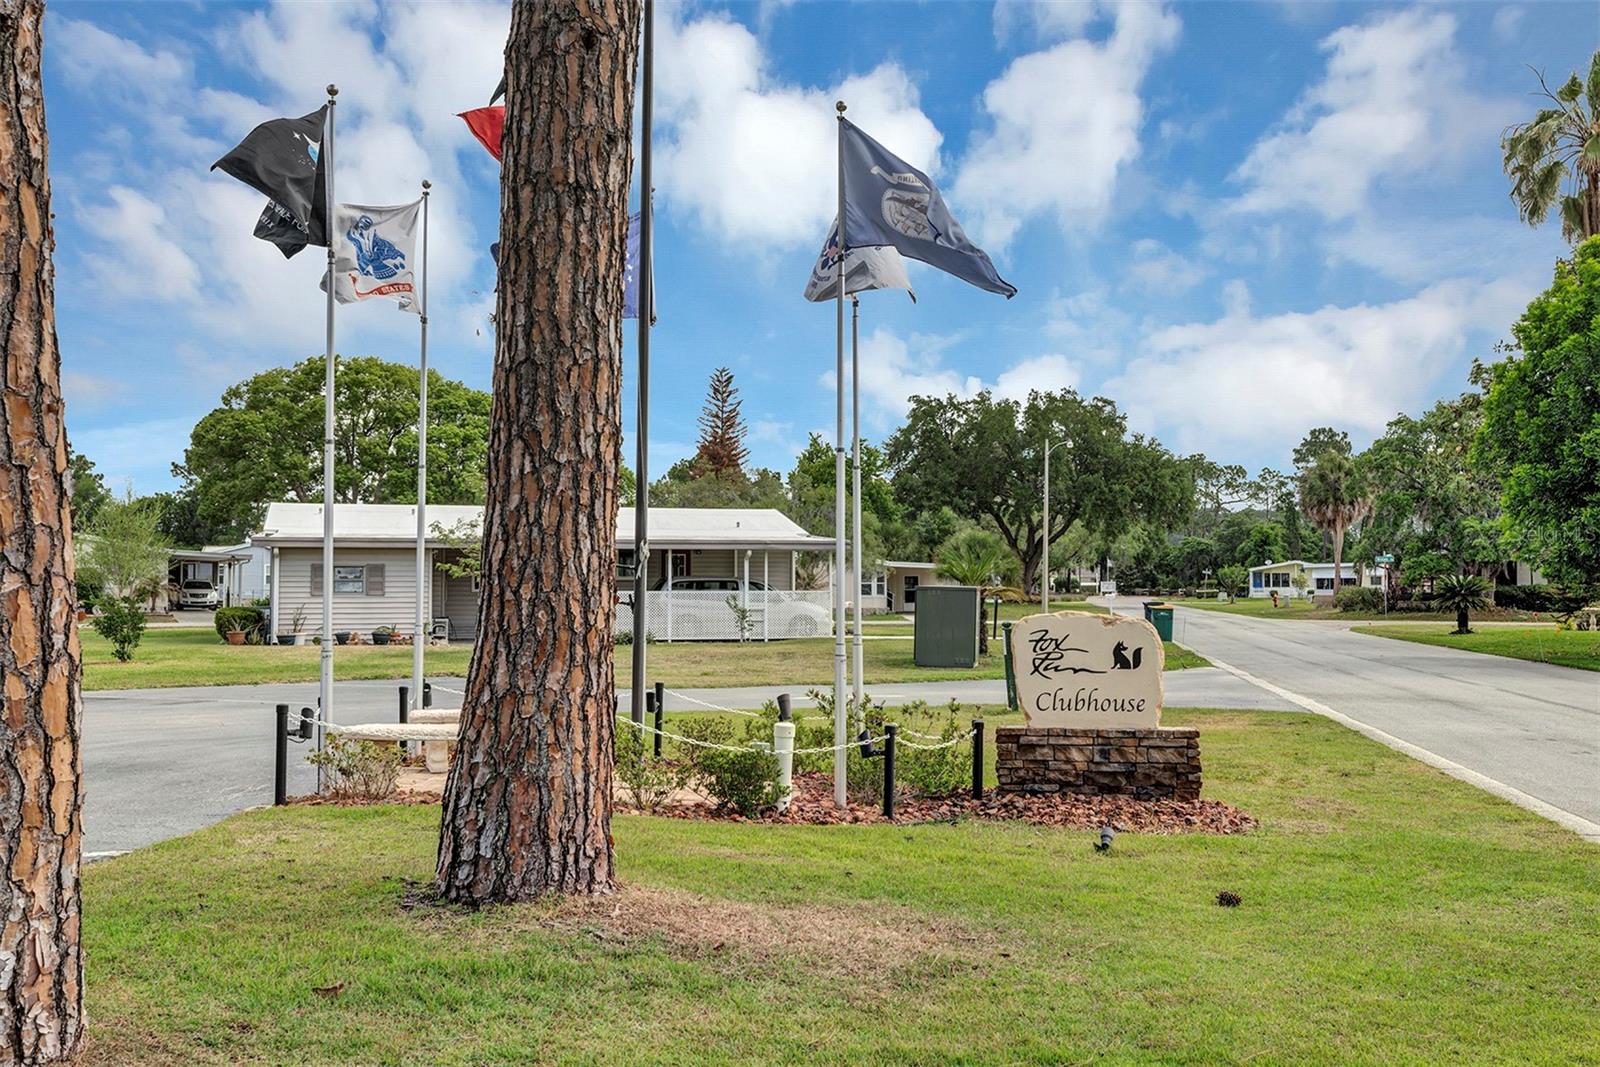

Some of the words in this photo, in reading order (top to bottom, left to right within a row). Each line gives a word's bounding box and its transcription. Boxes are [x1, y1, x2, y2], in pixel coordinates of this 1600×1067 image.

[1028, 629, 1089, 653] Fox
[1030, 651, 1108, 680] Run
[1036, 687, 1146, 712] Clubhouse
